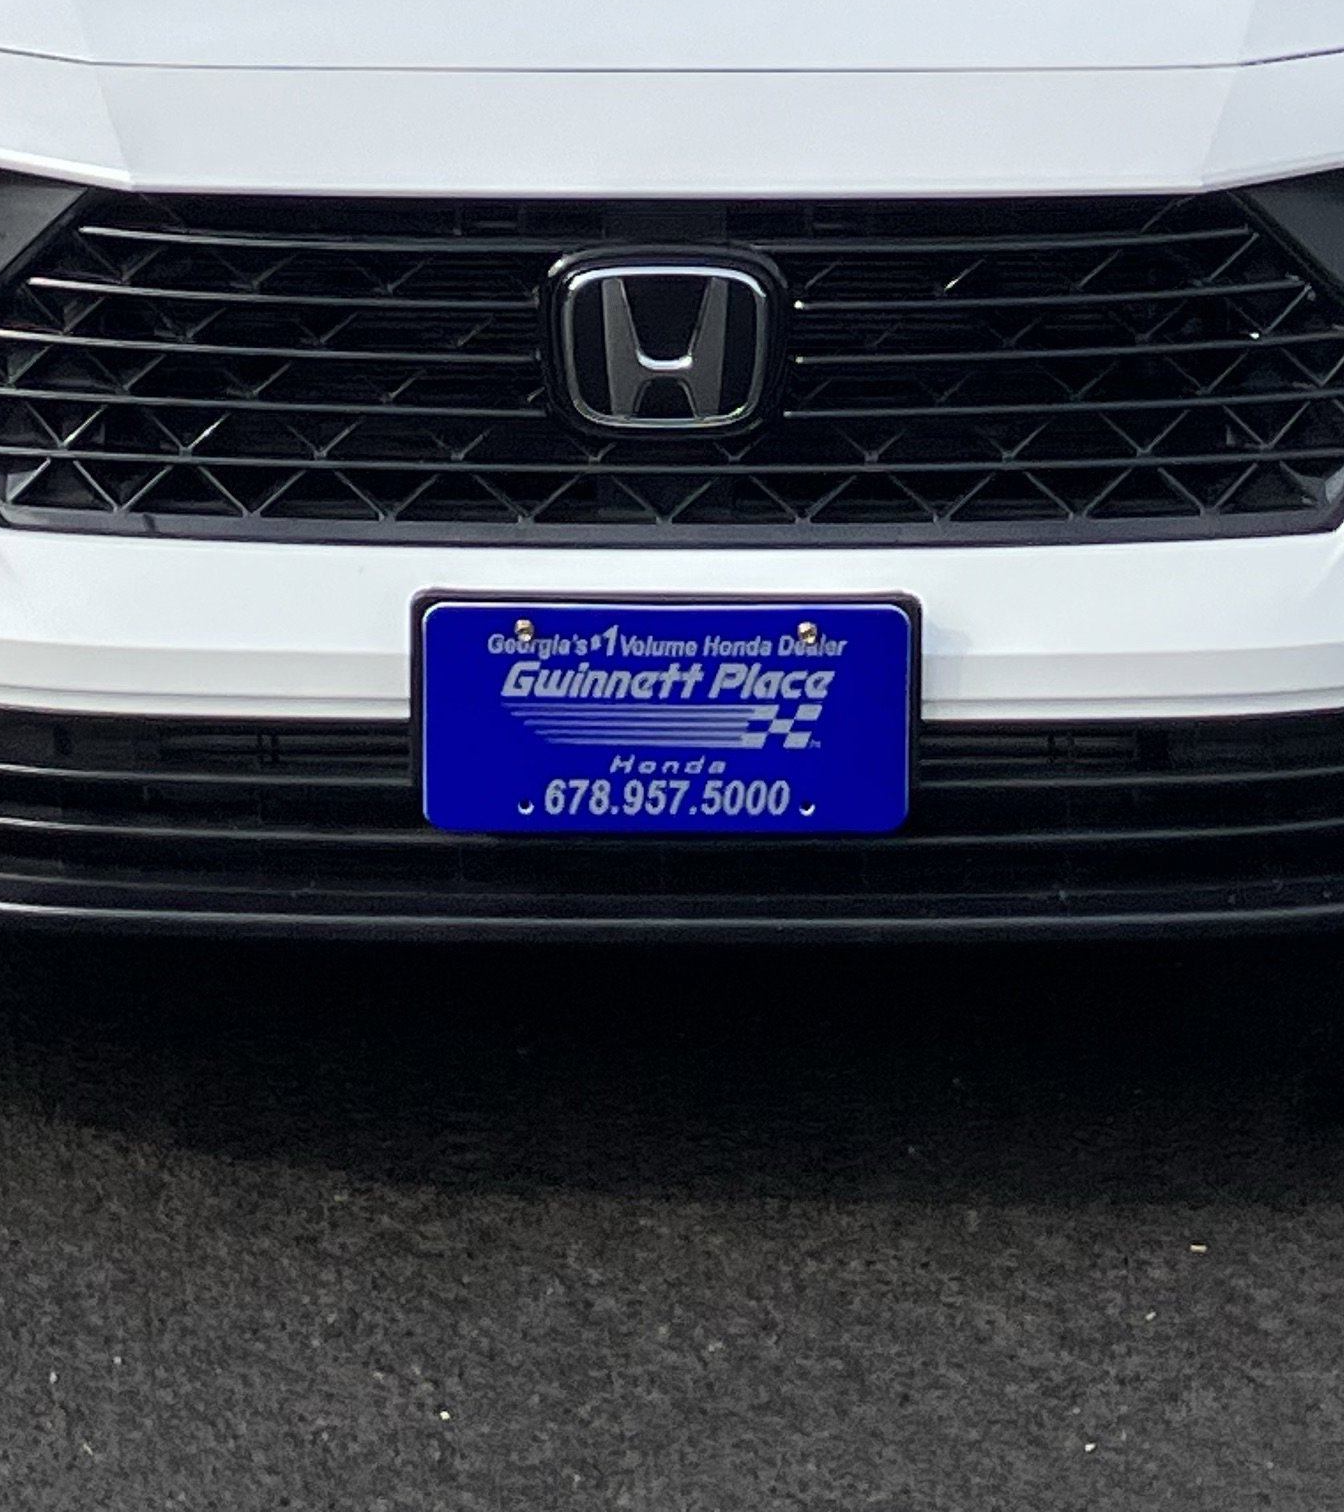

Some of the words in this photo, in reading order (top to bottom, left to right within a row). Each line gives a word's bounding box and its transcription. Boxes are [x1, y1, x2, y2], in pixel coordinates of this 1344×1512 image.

[488, 633, 588, 660] Georgia's
[621, 634, 698, 657] Volume
[702, 635, 772, 657] Honda
[777, 634, 848, 656] Dealer
[500, 661, 704, 699] Gwinnett
[708, 662, 836, 699] Place
[610, 755, 726, 775] Honda
[544, 779, 791, 816] 678.957.5000
